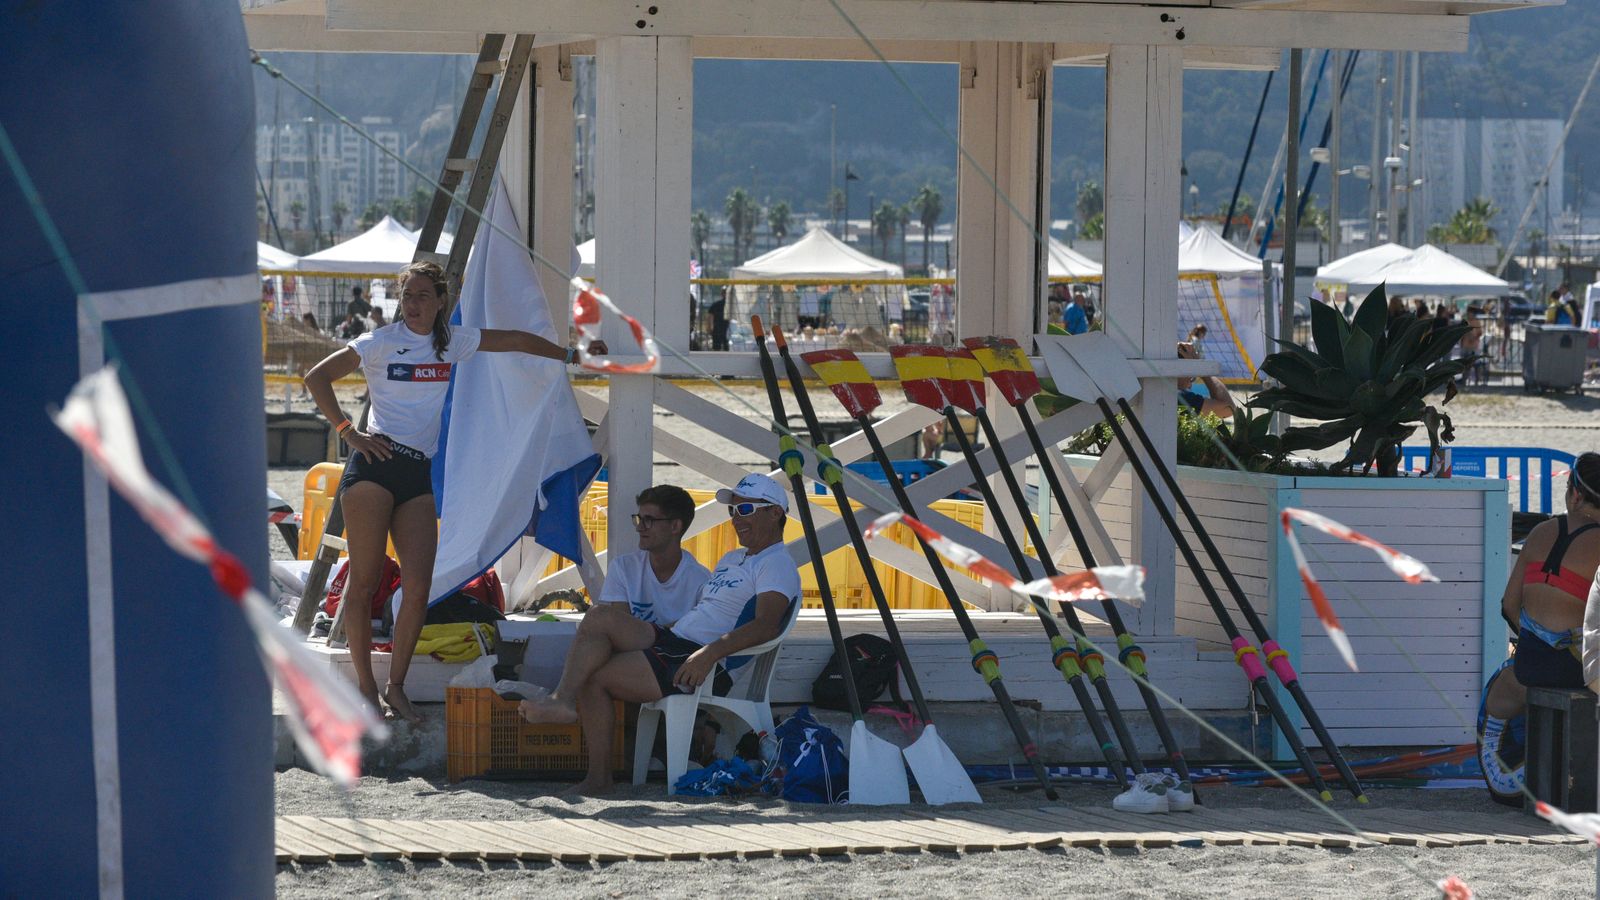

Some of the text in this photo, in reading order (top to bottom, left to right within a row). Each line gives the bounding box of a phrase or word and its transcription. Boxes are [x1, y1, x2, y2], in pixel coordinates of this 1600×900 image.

[415, 368, 436, 378] RCN
[389, 442, 421, 460] NIKE
[526, 734, 572, 745] TRES PUENTES
